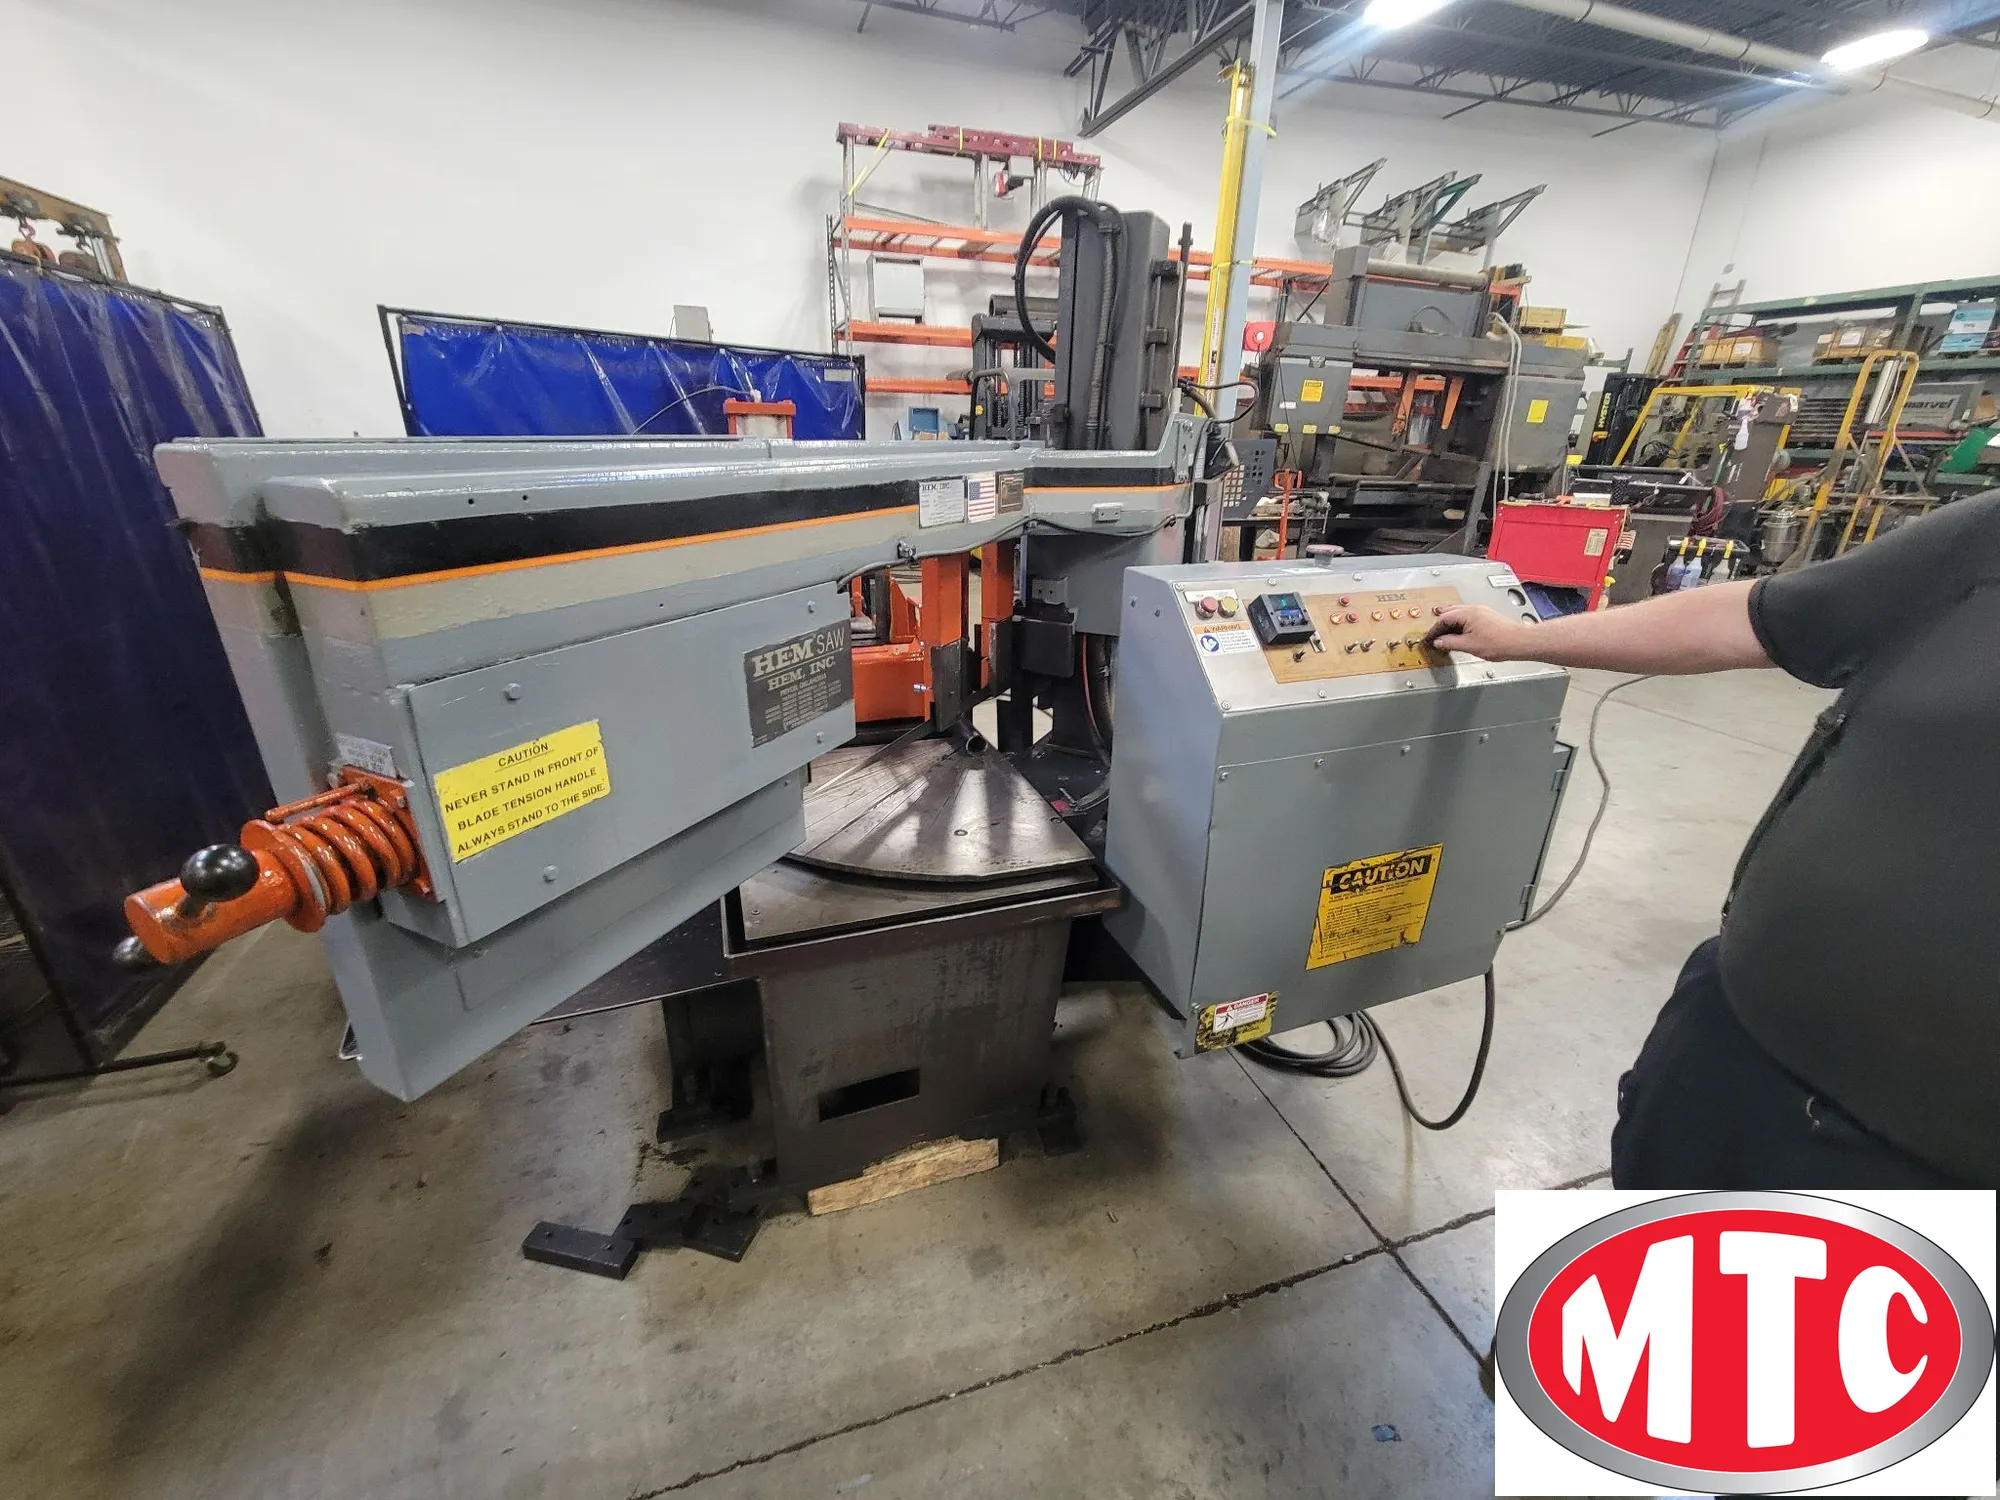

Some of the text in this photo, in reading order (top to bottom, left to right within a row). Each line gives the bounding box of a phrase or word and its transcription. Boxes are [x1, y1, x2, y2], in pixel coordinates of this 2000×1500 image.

[1598, 393, 1611, 428] HYSTER
[1376, 593, 1406, 602] HEM
[752, 627, 845, 678] HEM SAW
[498, 742, 549, 767] CAUTION
[445, 746, 599, 813] NEVER STAND IN FRONT OF
[458, 767, 597, 831] BLADE TENSION HANDLE
[457, 826, 505, 853] ALWAYS
[508, 810, 543, 831] STAND
[545, 803, 559, 815] TO
[562, 795, 580, 807] THE
[1340, 858, 1425, 890] CAUTION
[1233, 998, 1260, 1009] DANGER
